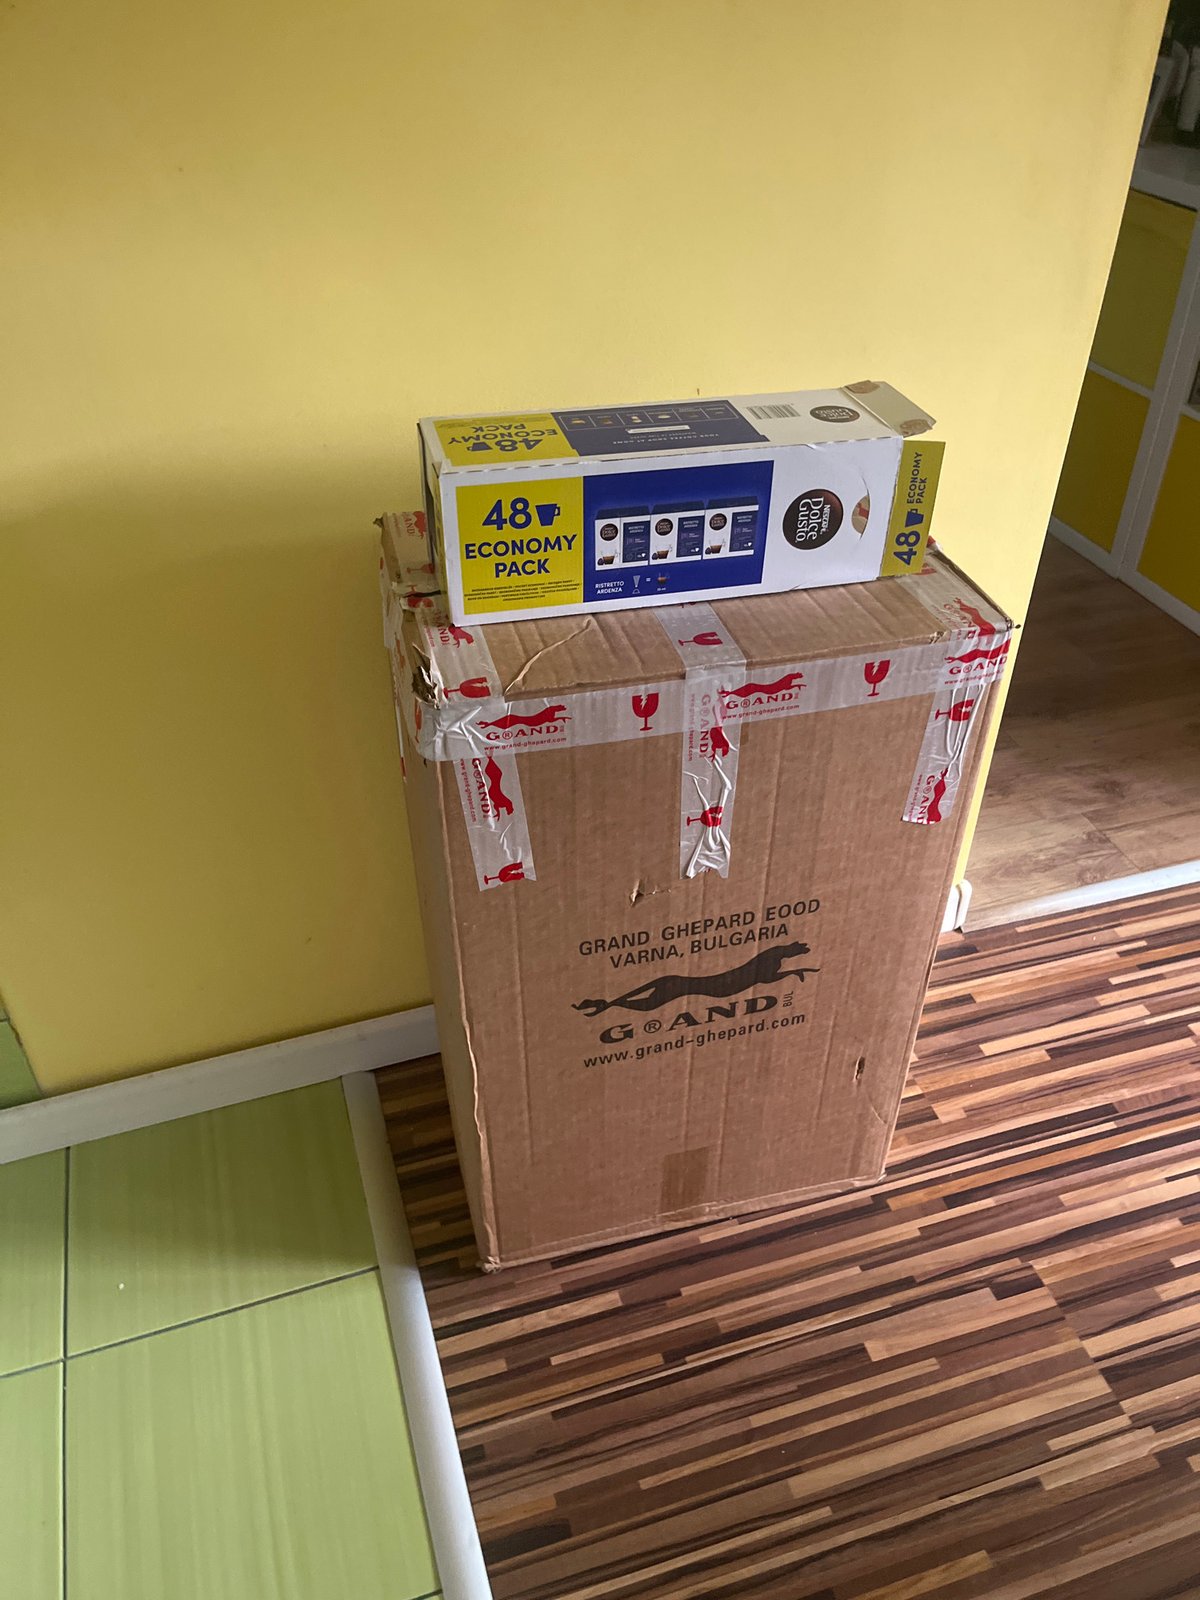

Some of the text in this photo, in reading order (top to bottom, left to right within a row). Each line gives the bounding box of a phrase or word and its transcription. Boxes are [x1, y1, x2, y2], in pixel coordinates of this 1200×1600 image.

[448, 429, 558, 445] ECONOMY
[472, 423, 526, 433] PACK
[495, 439, 543, 452] 48
[907, 452, 923, 504] ECONOMY
[916, 477, 928, 504] PACK
[482, 497, 532, 531] 48
[807, 496, 825, 540] Dolce
[465, 534, 578, 560] ECONOMY
[894, 530, 921, 566] 48
[495, 558, 551, 578] PACK
[595, 581, 625, 589] RISTRETTO
[596, 587, 623, 595] ARDENZA
[579, 898, 820, 956] GRAND GHEPARD EOOD
[610, 923, 789, 969] VARNA, BULGARIA
[783, 991, 794, 1008] BUL
[583, 1013, 805, 1068] www.grand-ghepard.com
